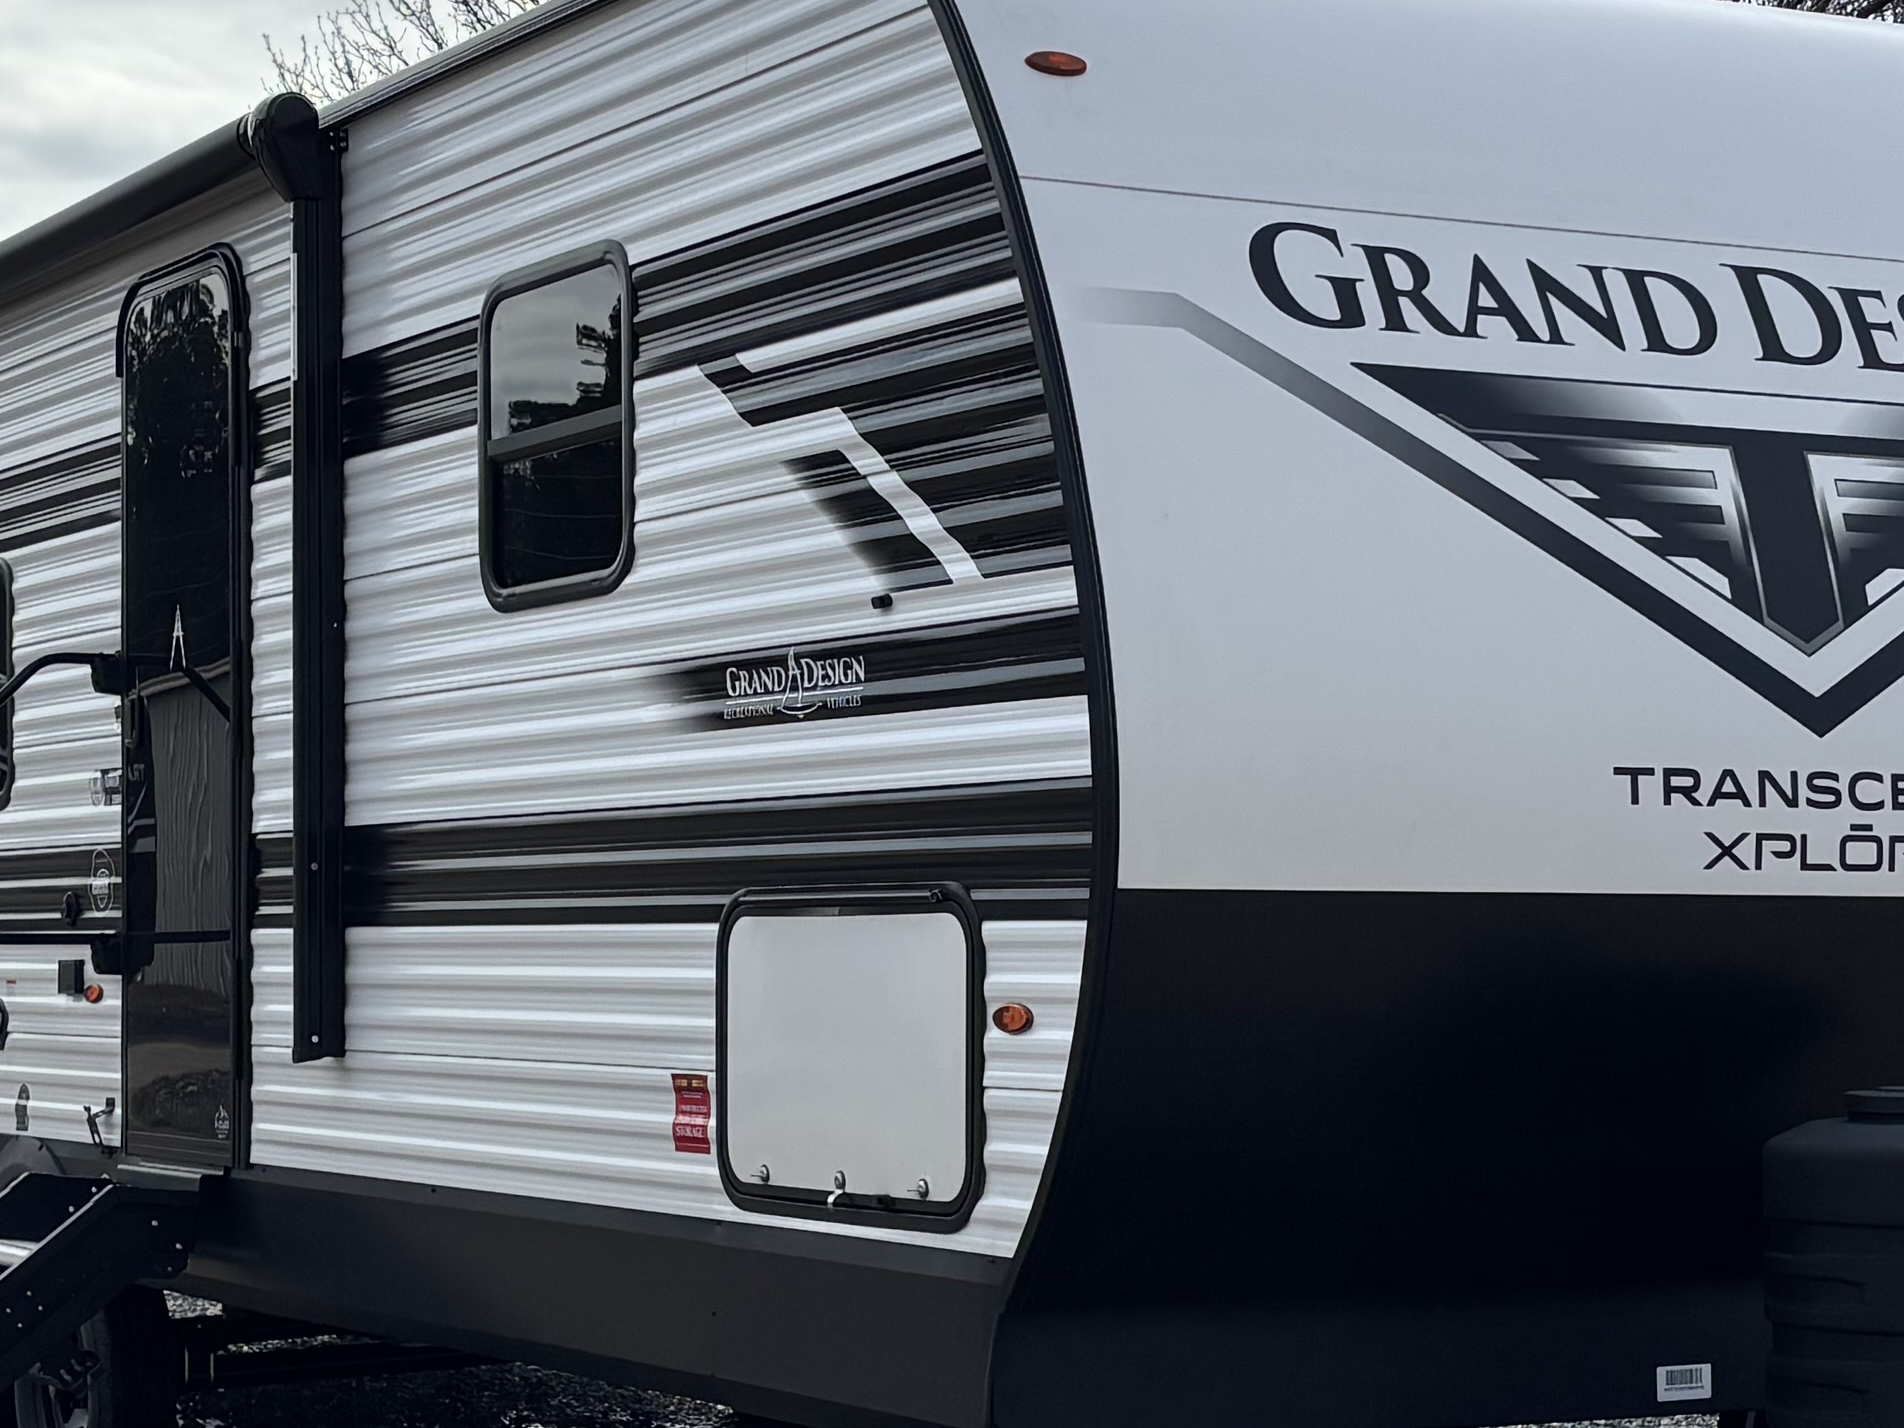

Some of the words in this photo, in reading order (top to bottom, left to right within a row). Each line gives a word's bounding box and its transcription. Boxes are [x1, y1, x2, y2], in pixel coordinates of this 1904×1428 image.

[1248, 221, 1718, 357] GRAND
[726, 667, 786, 697] GRAND
[799, 655, 866, 689] DESIGN
